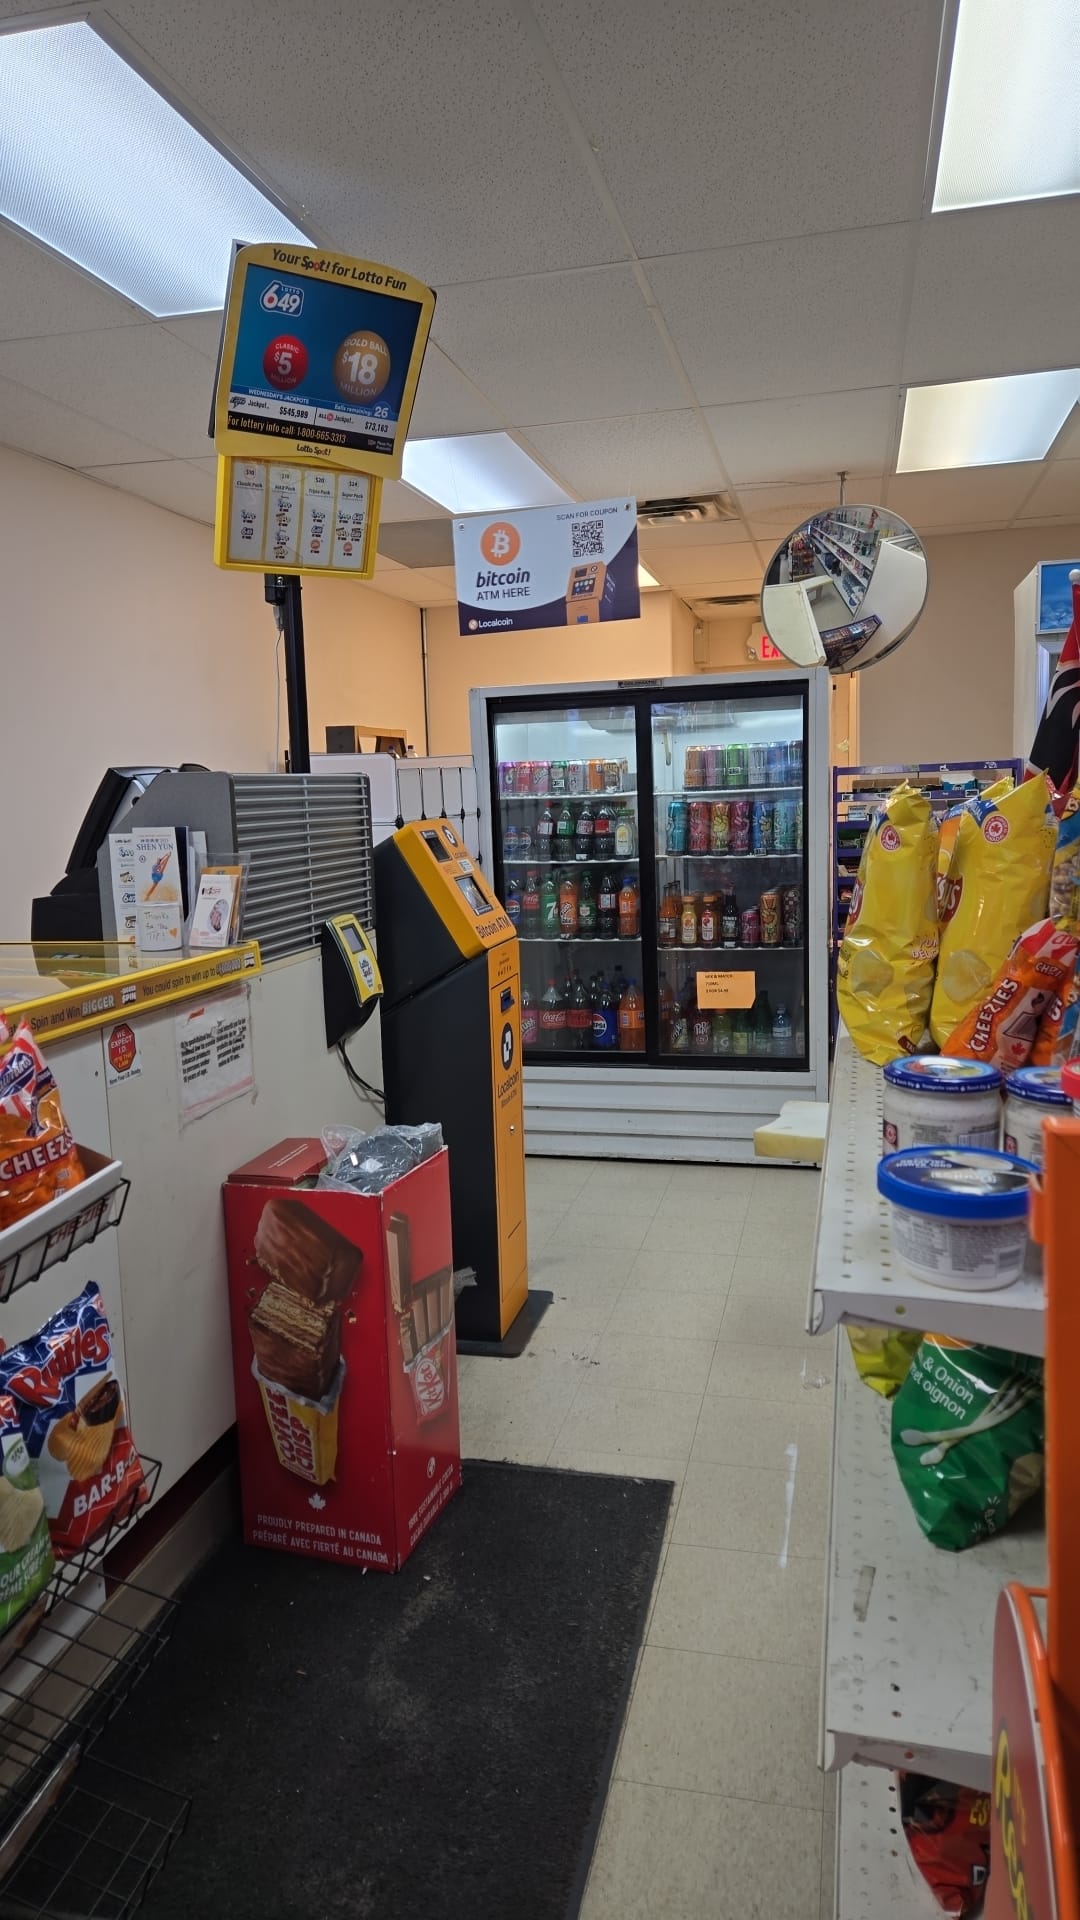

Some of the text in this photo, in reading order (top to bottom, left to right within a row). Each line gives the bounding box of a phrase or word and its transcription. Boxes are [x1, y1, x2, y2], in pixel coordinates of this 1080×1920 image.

[273, 248, 407, 291] Your Spot! for Lotto Fun
[275, 343, 300, 354] CLASSIC
[273, 350, 292, 375] $5
[342, 349, 378, 385] $18
[341, 381, 377, 397] MILLION
[228, 415, 240, 425] For
[240, 417, 265, 432] lottery
[265, 422, 280, 433] info
[374, 406, 389, 418] 26
[296, 443, 331, 456] Lotto Spot!
[556, 507, 618, 521] SCAN FOR COUPON
[476, 567, 530, 588] bitcoin
[476, 586, 530, 601] ATM HERE
[478, 617, 513, 628] Localcoin
[136, 843, 174, 851] SHEN YUN
[476, 915, 512, 939] Bitcoin ATM
[143, 985, 154, 996] You
[155, 982, 171, 992] could
[172, 977, 184, 990] spin
[185, 975, 191, 983] to
[192, 972, 201, 981] win
[202, 970, 209, 980] up
[210, 968, 215, 976] to
[121, 993, 137, 1004] SPIN
[31, 1016, 48, 1030] Spin
[51, 1011, 64, 1025] and
[65, 1007, 80, 1019] Win
[82, 995, 115, 1017] BIGGER
[970, 978, 1019, 1052] CHEEZIES
[117, 1030, 126, 1039] WE
[520, 1018, 536, 1032] rush
[111, 1034, 132, 1049] EXPECT
[497, 1070, 520, 1098] Localcoin
[6, 1323, 111, 1409] Ruffles
[923, 1356, 974, 1405] & Onion
[922, 1380, 967, 1420] oignon
[266, 1387, 296, 1461] COFFEE
[290, 1415, 314, 1471] CRISP
[257, 1514, 382, 1546] PROUDLY PREPARED IN CANADA
[253, 1529, 389, 1563] PRÉPARÉ AVEC FIERTÉ AU CANADA
[0, 1563, 21, 1588] OUR
